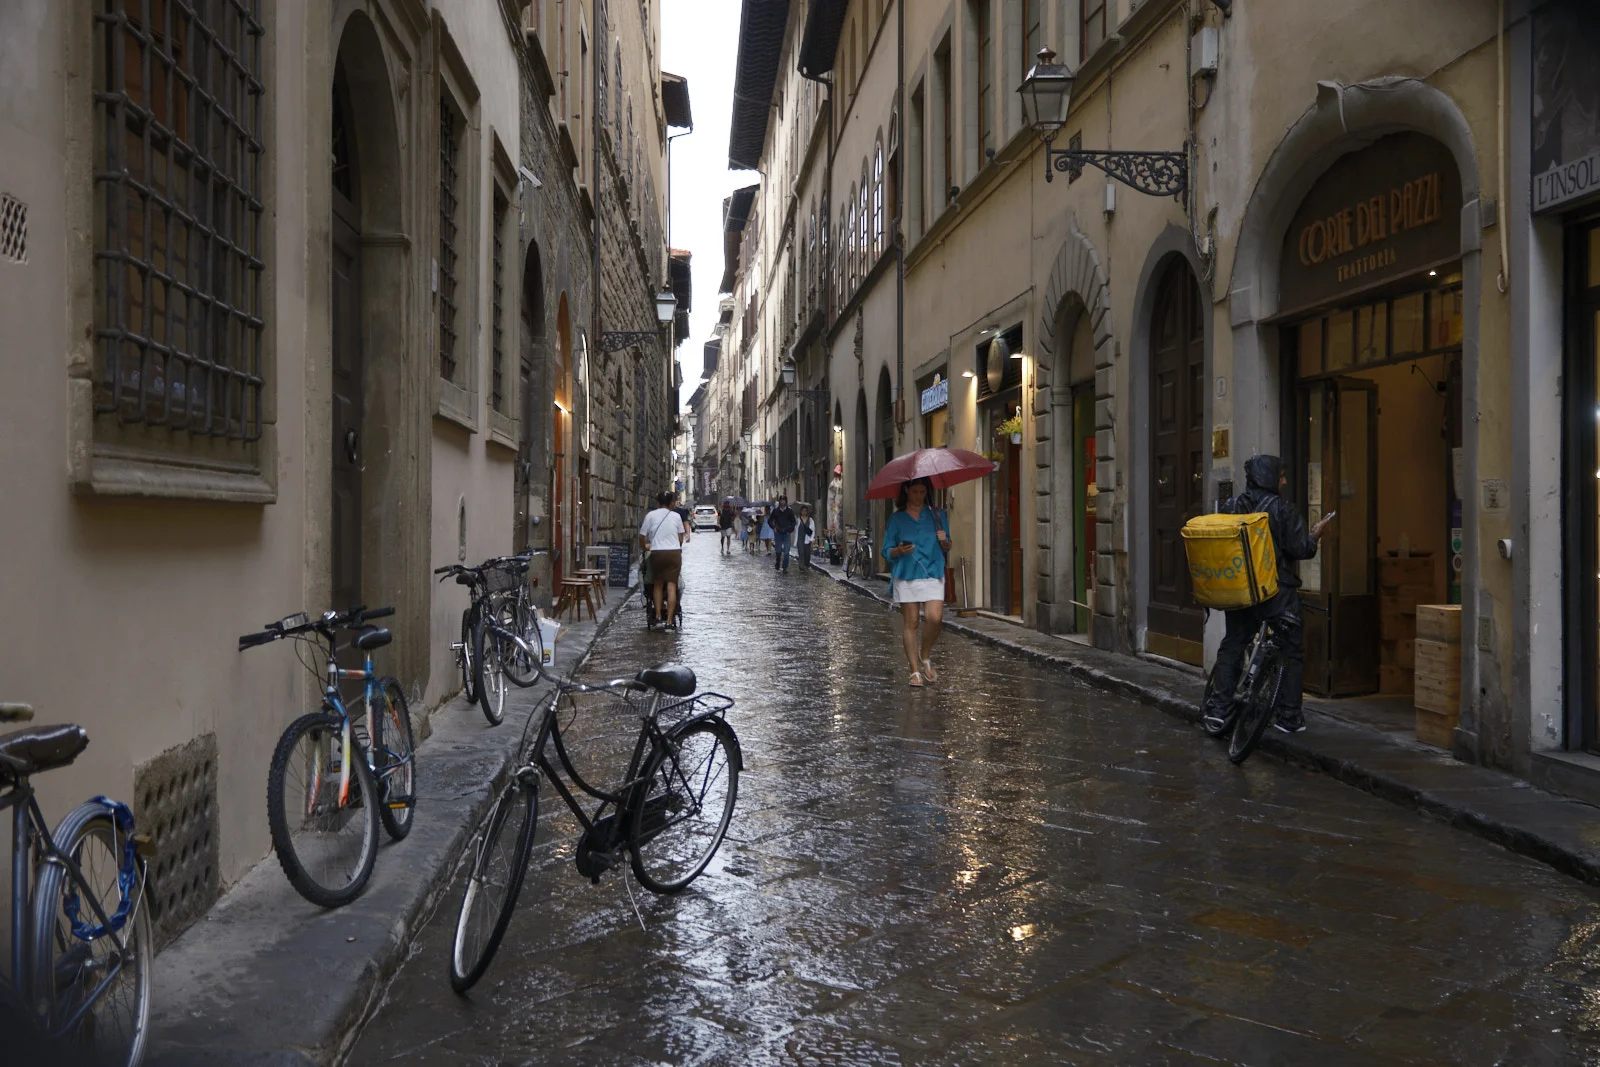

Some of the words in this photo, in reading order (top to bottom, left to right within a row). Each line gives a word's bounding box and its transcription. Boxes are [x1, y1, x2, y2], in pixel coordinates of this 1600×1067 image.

[1538, 154, 1600, 205] L'INSOL
[1299, 207, 1354, 266] CORTE
[1357, 194, 1387, 248] DEI
[1390, 172, 1441, 235] PAZZI
[1336, 247, 1397, 282] TRATTORIA
[1190, 562, 1236, 579] Glovo
